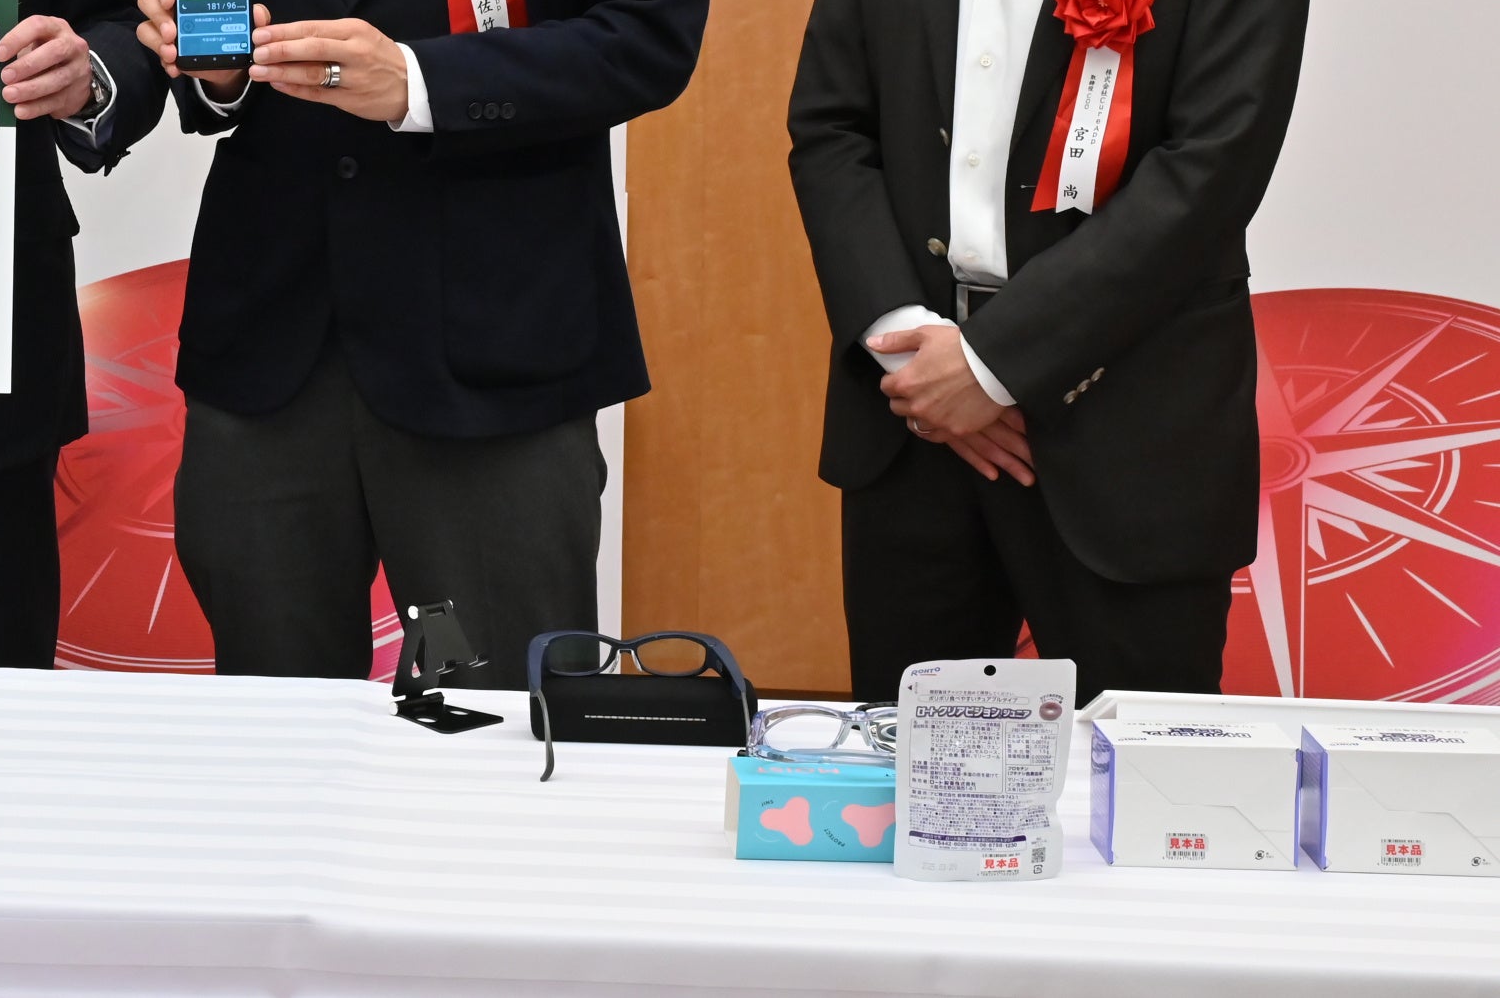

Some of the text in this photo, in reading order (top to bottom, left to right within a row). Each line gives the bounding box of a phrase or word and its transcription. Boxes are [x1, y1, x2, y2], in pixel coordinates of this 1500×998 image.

[910, 666, 941, 677] ROHTO
[1169, 837, 1205, 850] 見本品
[1385, 844, 1422, 856] 見本品
[984, 857, 1020, 870] 見本品
